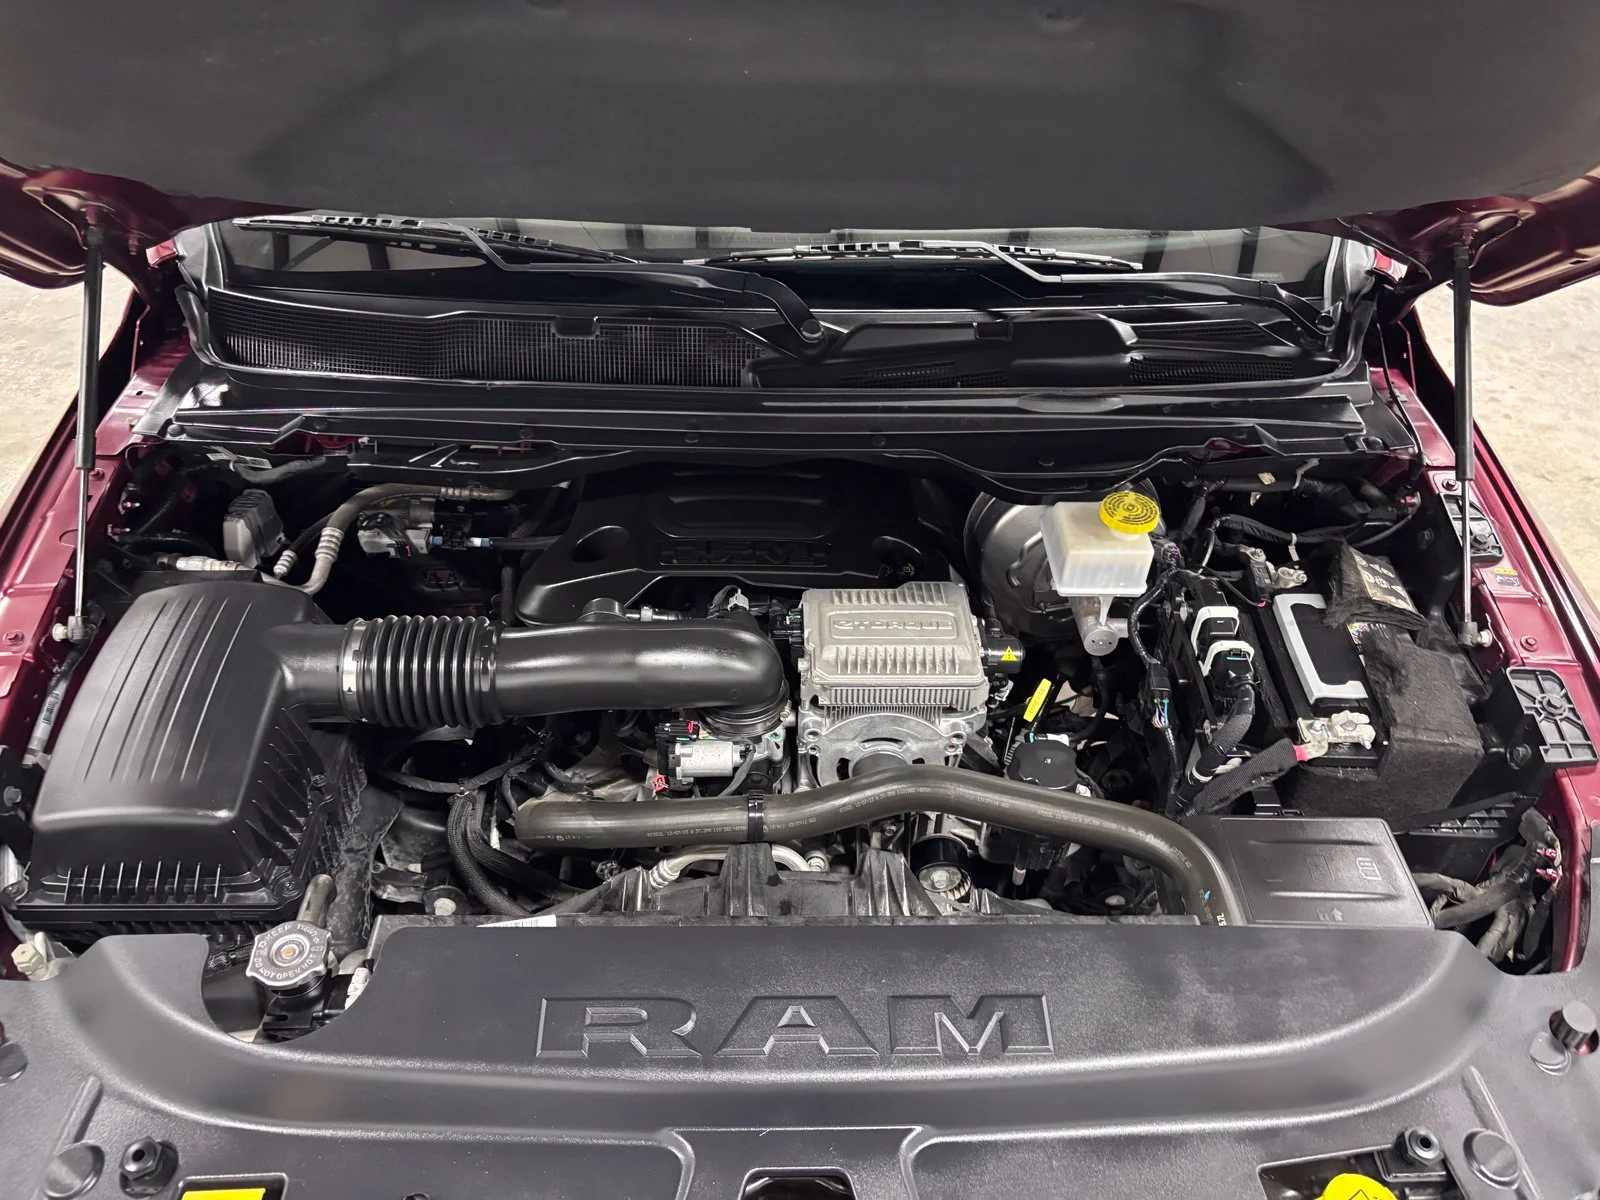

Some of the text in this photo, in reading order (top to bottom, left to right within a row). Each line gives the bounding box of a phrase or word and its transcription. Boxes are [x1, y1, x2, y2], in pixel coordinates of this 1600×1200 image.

[265, 924, 292, 941] KEEP
[276, 967, 302, 980] OPEN
[535, 994, 1055, 1059] RAM
